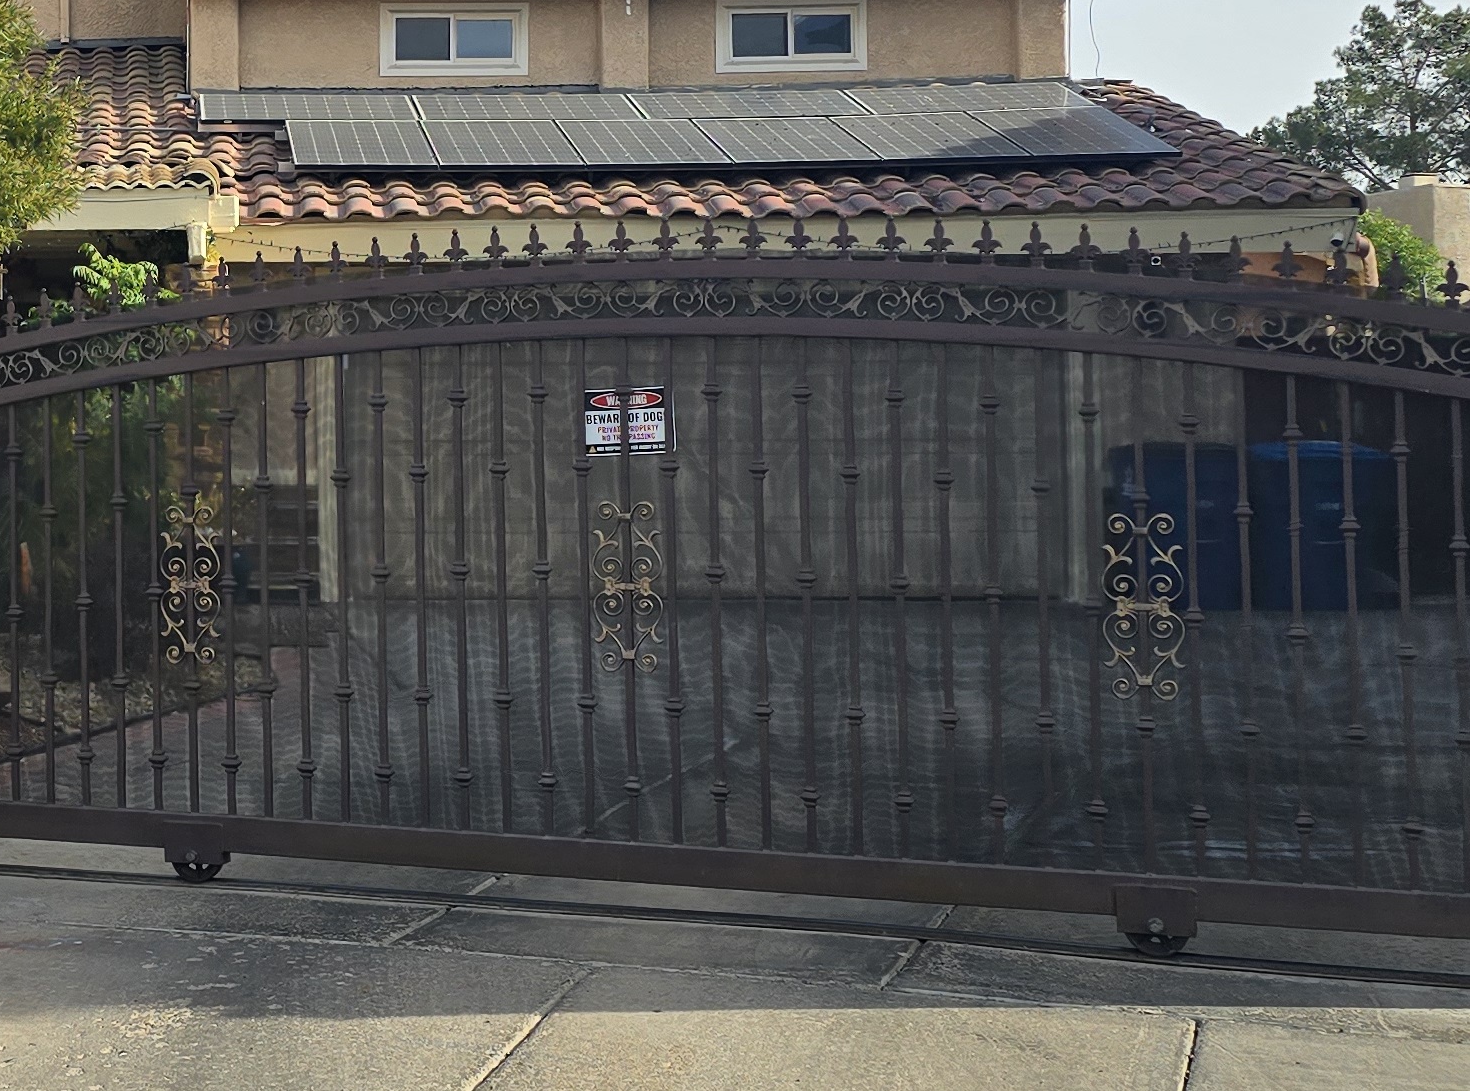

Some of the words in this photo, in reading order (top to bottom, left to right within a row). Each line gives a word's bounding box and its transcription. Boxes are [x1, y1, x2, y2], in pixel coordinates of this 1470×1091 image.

[606, 394, 647, 406] WANING
[586, 414, 622, 424] BEWAR
[628, 412, 639, 423] OF
[643, 412, 662, 422] DOG
